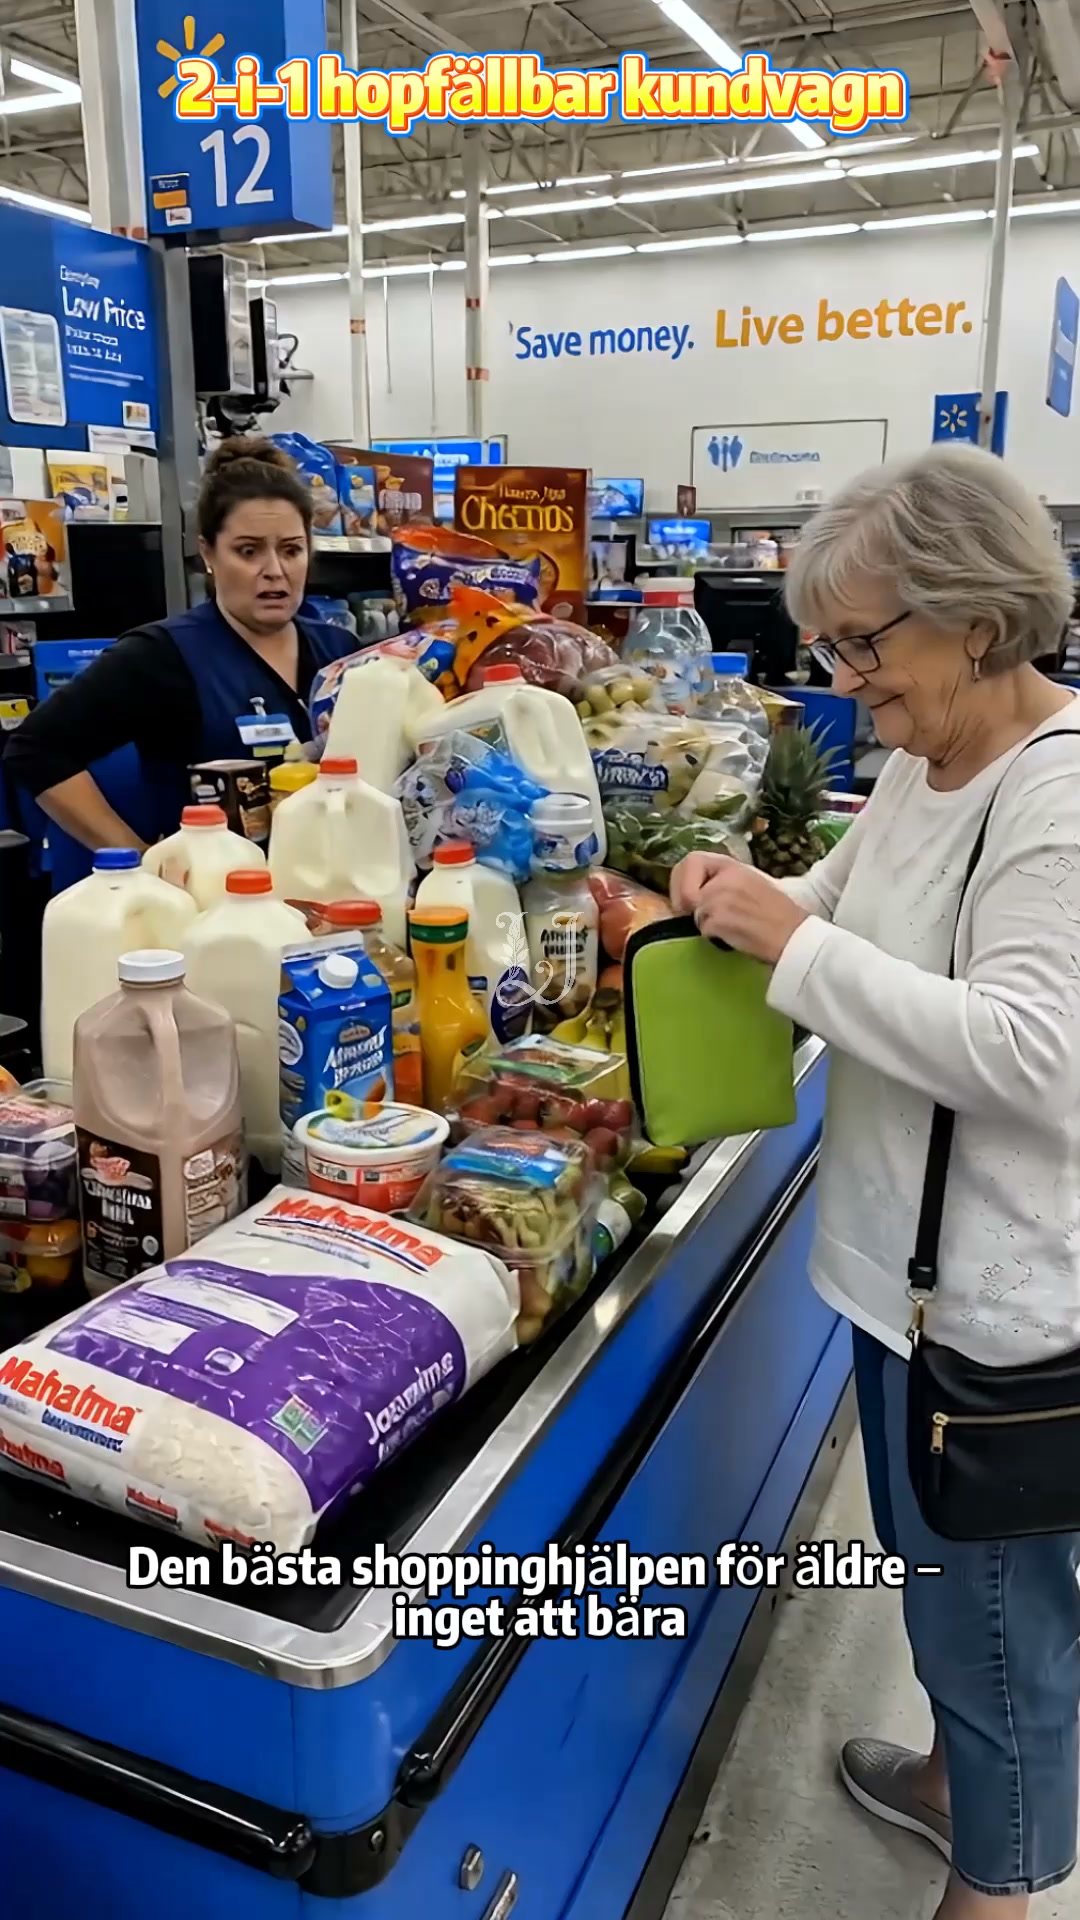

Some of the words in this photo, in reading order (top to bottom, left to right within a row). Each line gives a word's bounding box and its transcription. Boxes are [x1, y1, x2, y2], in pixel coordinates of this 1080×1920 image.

[200, 124, 274, 207] 12
[515, 326, 582, 360] Save
[590, 324, 694, 360] money.
[715, 306, 804, 348] Live
[818, 298, 972, 341] better.
